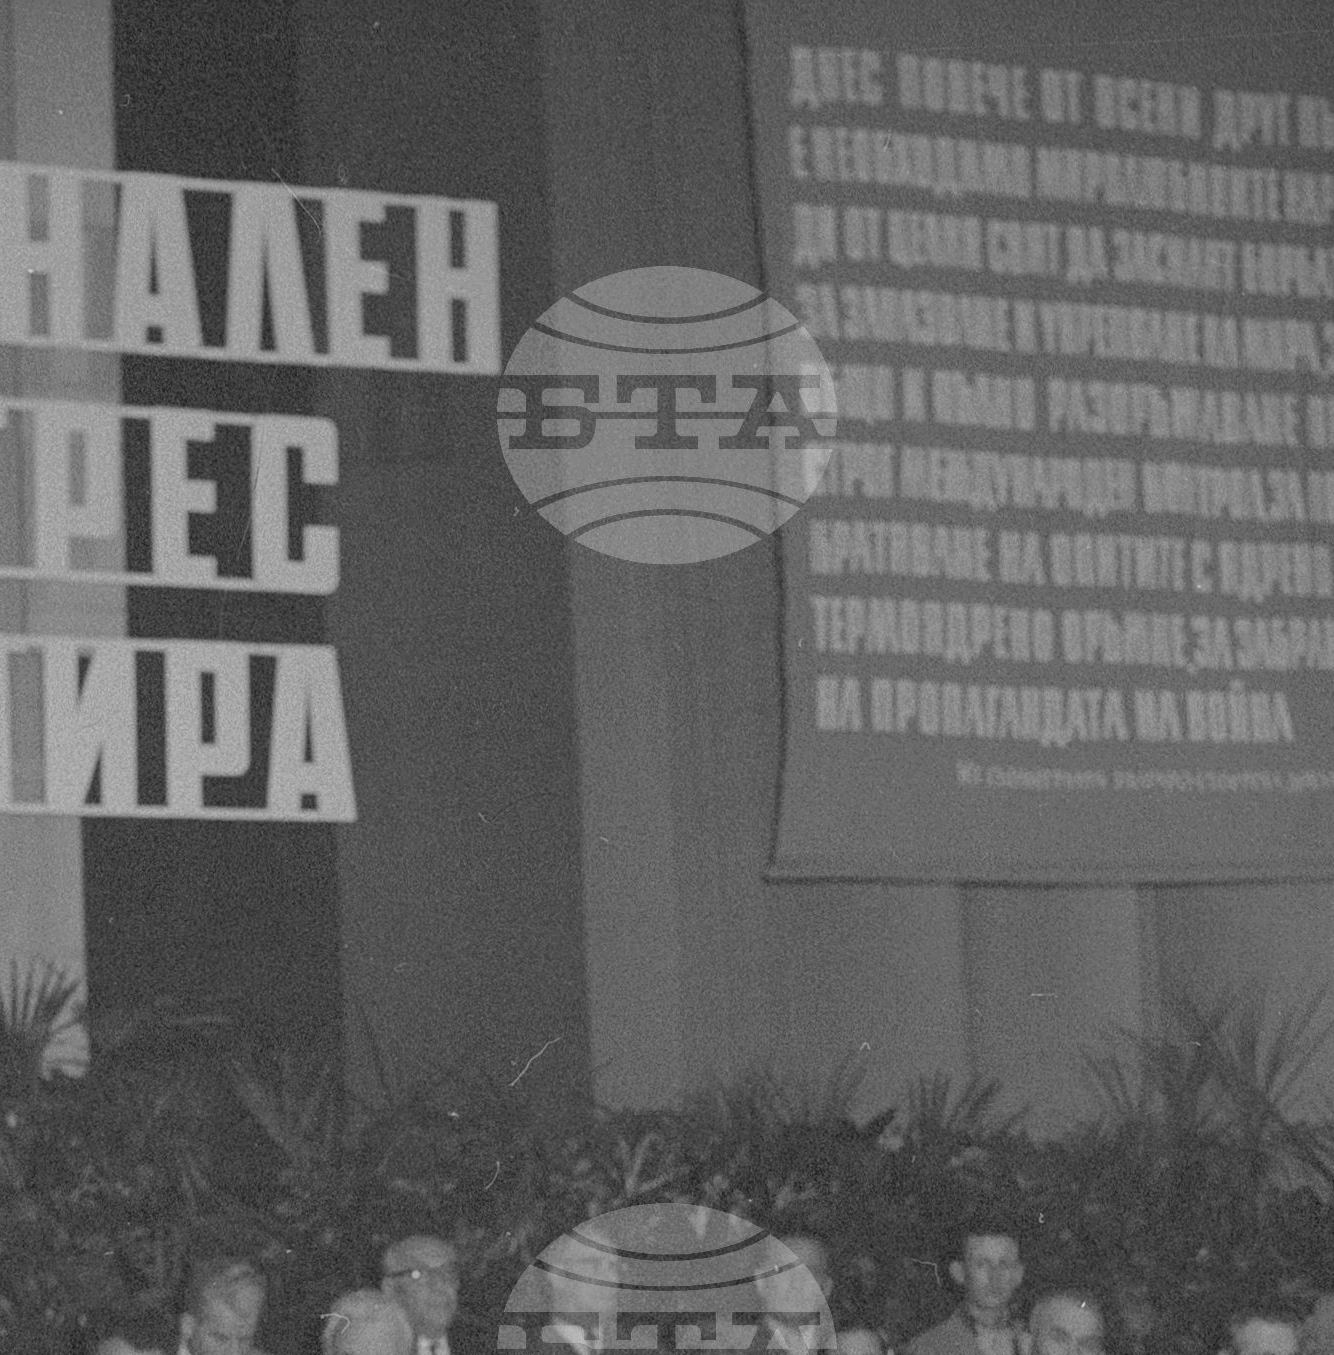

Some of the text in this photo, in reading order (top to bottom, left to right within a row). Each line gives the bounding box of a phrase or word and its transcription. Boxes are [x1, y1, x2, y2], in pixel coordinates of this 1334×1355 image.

[789, 45, 884, 110] ДНЕС
[897, 52, 1031, 120] ПОВЕЧЕ
[1040, 67, 1084, 124] ОТ
